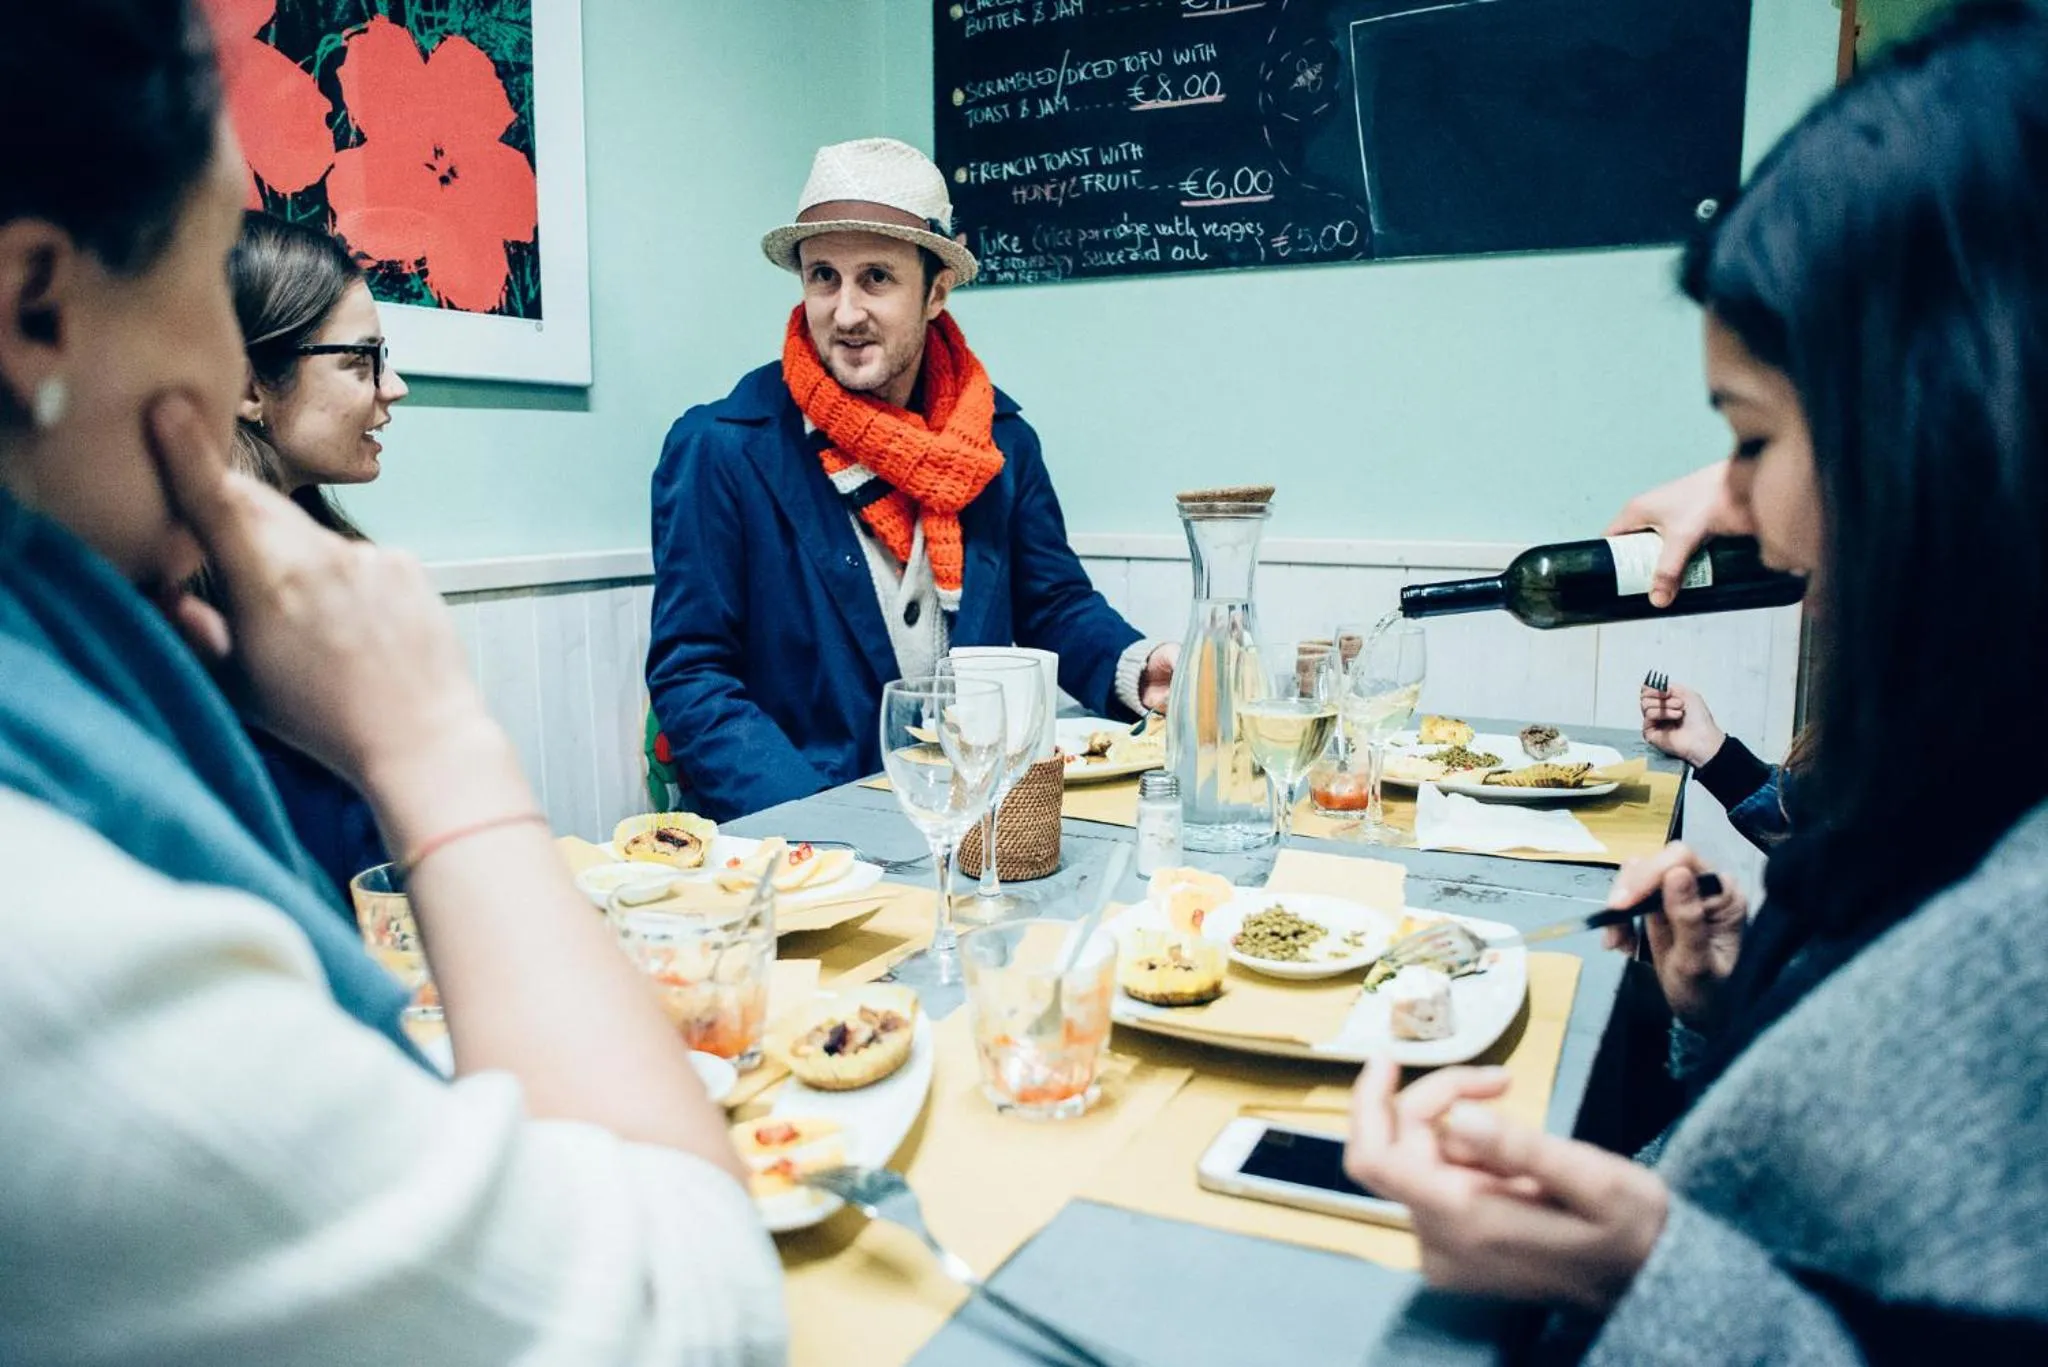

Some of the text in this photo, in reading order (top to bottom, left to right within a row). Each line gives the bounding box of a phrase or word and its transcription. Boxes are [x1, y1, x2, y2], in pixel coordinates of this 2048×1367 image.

[965, 8, 1026, 38] BUTTER
[1050, 0, 1084, 21] JAM
[1120, 48, 1163, 73] TOFU
[1174, 42, 1217, 66] WITH
[964, 103, 1010, 128] TOAST
[1036, 94, 1070, 119] JAM
[969, 141, 1143, 184] FRENCH TOAST WITH
[1080, 169, 1145, 193] FRUIT
[1155, 215, 1199, 238] with
